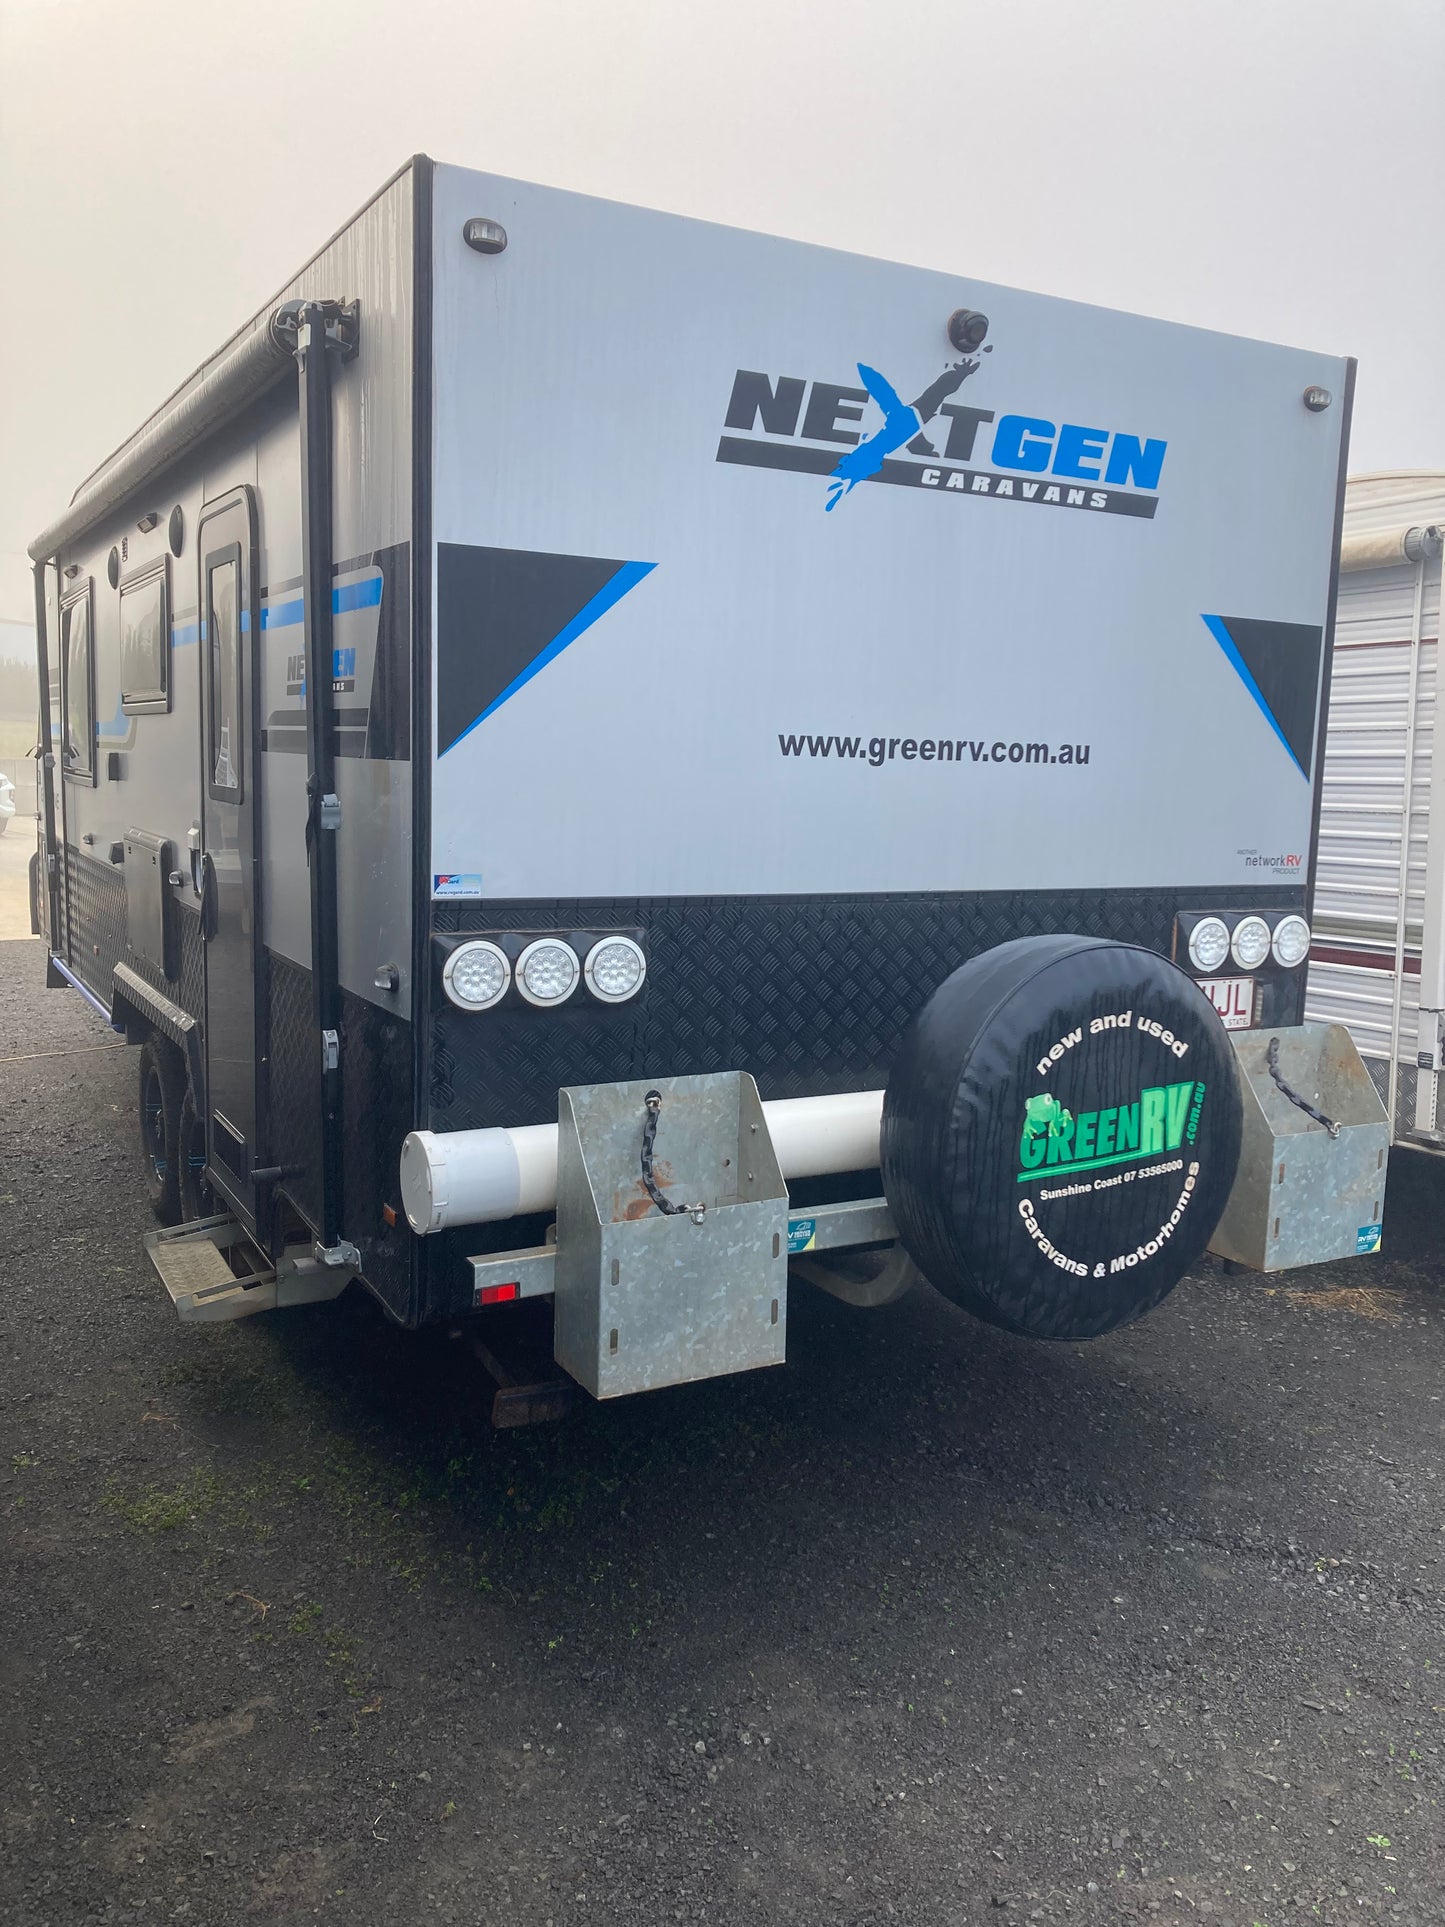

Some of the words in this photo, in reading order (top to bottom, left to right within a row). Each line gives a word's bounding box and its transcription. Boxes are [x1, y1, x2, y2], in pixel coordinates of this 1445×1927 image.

[722, 361, 1168, 496] NEXTGEN
[920, 468, 1108, 509] CARAVANS
[777, 734, 1091, 767] www.greenrv.com.au
[1245, 854, 1303, 867] networkRV
[1272, 867, 1301, 875] PRODUCT
[1035, 1027, 1083, 1075] new
[1089, 1010, 1133, 1035] and
[1136, 1016, 1190, 1059] used
[1188, 1081, 1207, 1146] .com.au
[1039, 1181, 1093, 1201] Sunshine
[1093, 1175, 1123, 1191] Coast
[1123, 1171, 1137, 1183] 07
[1017, 1198, 1089, 1278] Caravans
[1092, 1261, 1107, 1279] &
[1109, 1160, 1201, 1275] Motorhomes
